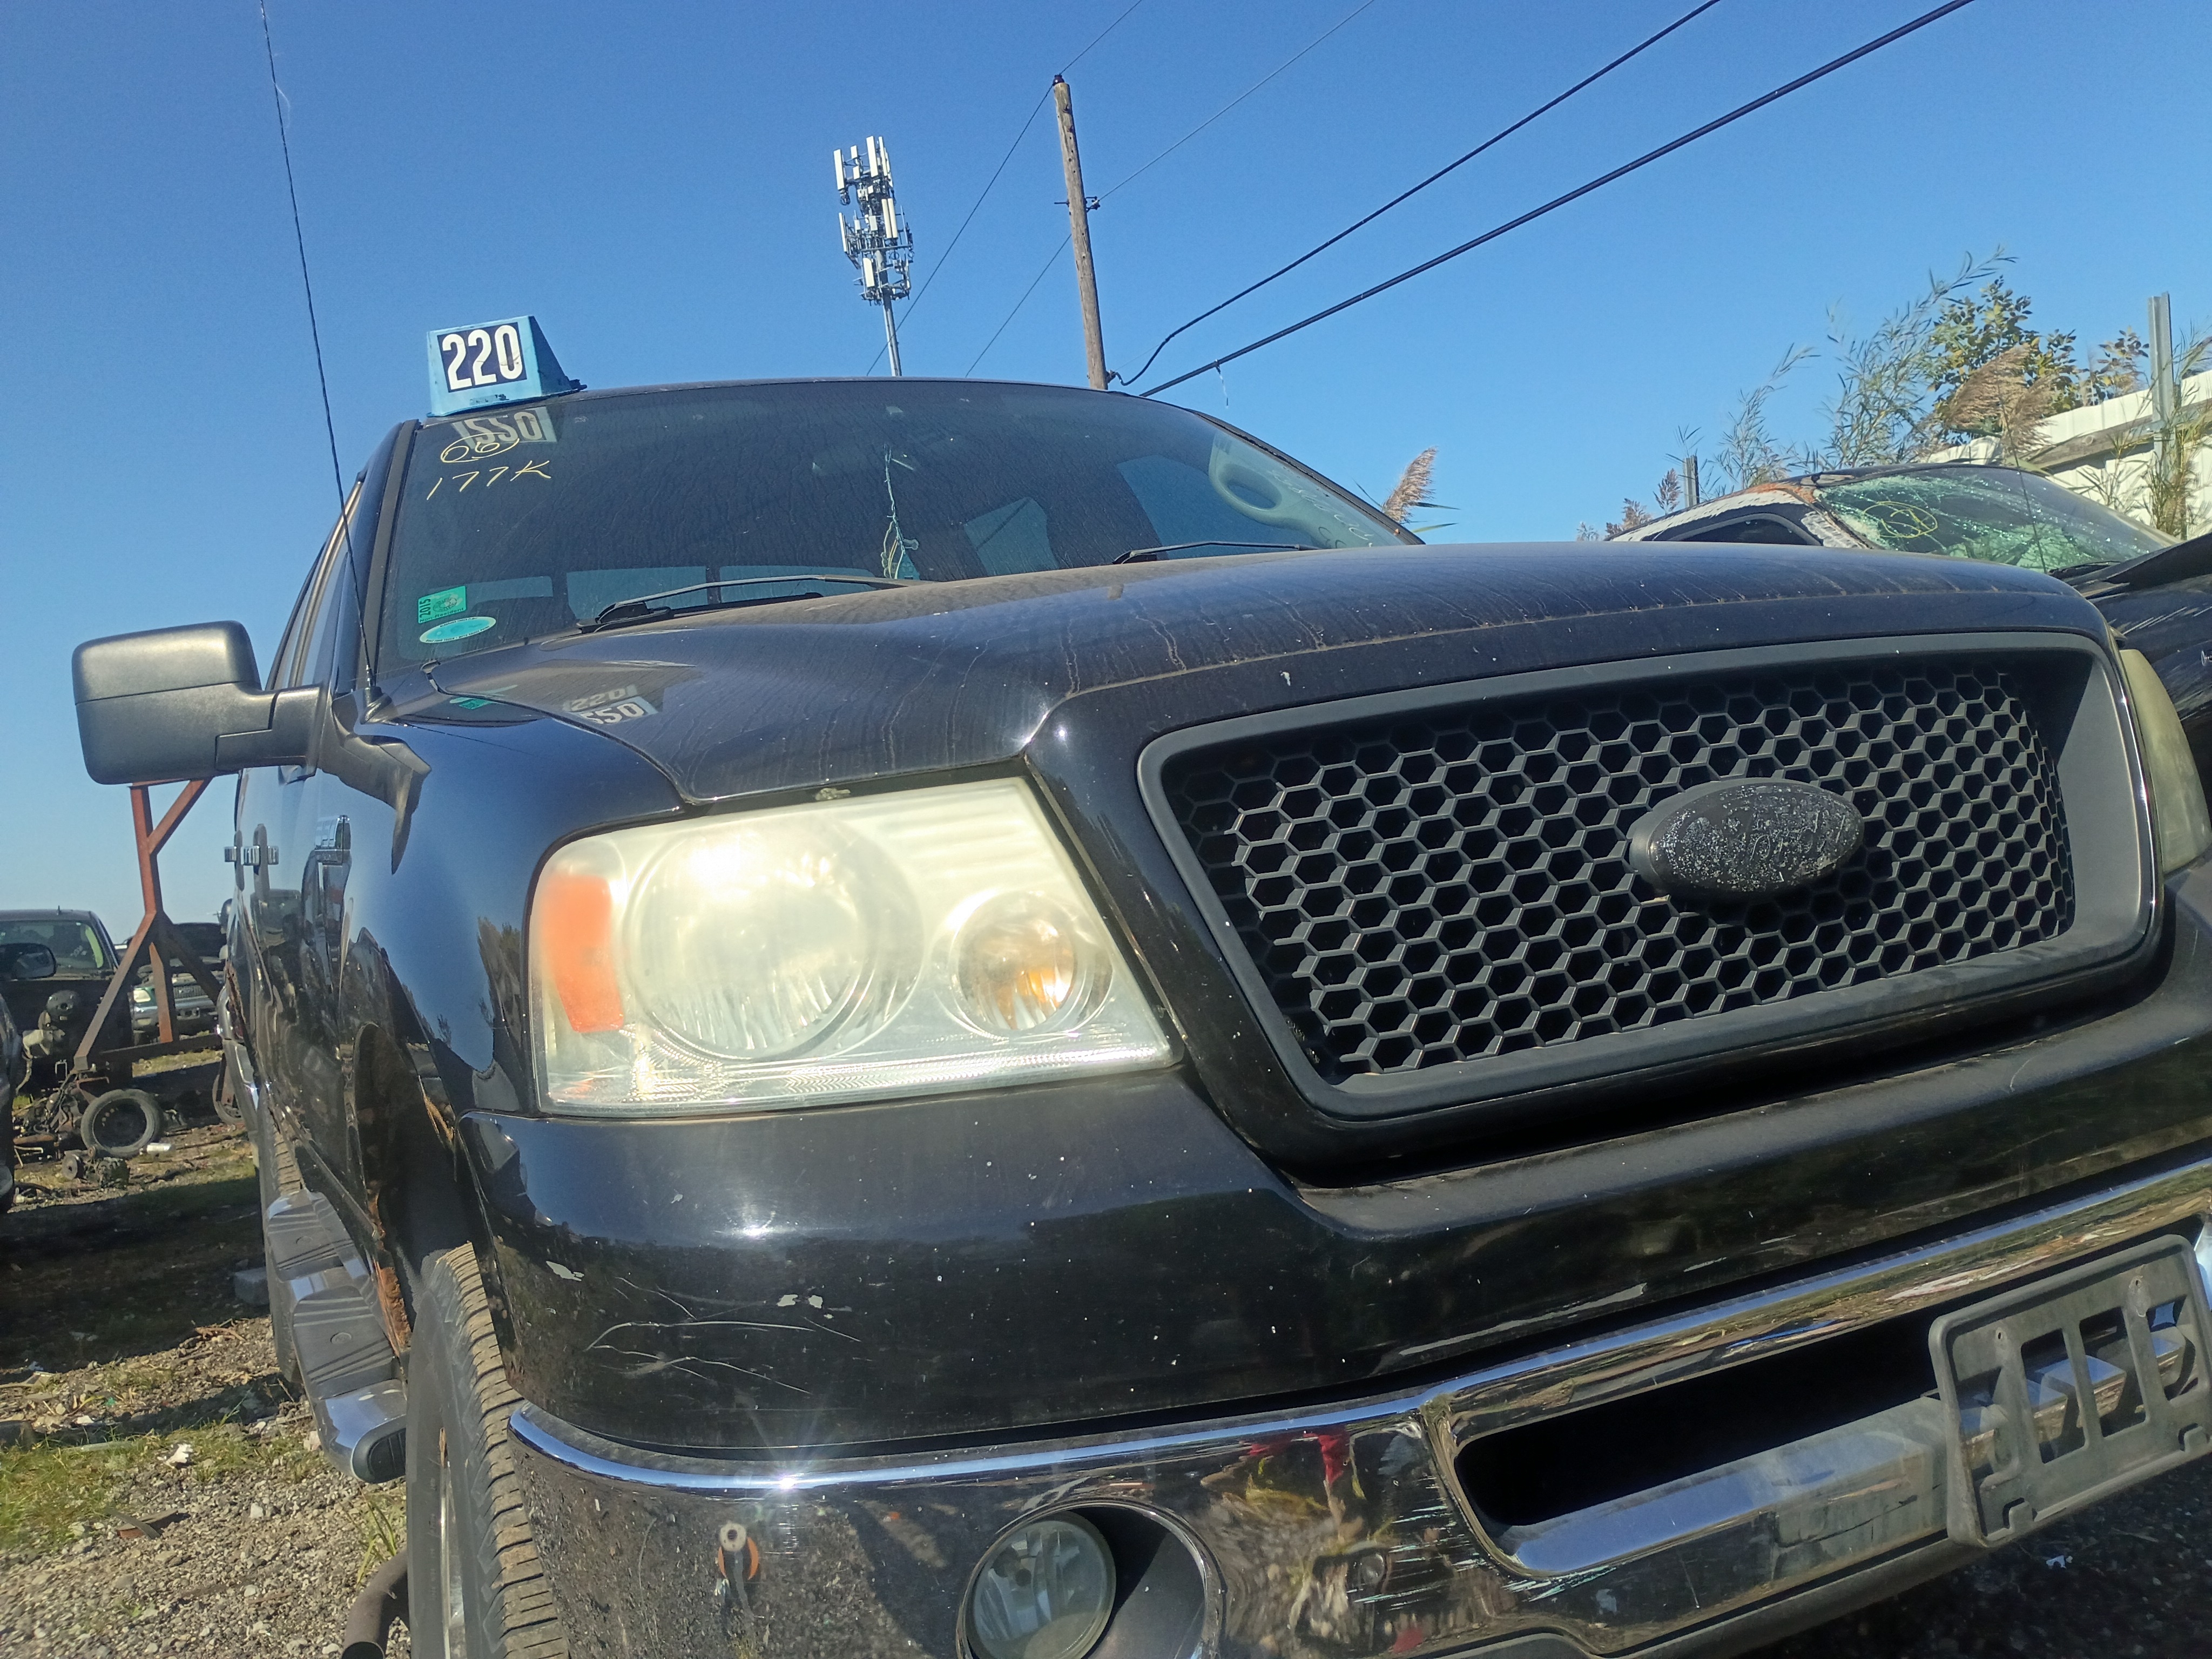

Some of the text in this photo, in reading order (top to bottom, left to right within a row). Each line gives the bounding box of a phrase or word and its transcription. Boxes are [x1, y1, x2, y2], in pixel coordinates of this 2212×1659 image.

[442, 324, 523, 390] 220
[426, 460, 551, 501] 177K
[419, 598, 431, 618] 2015
